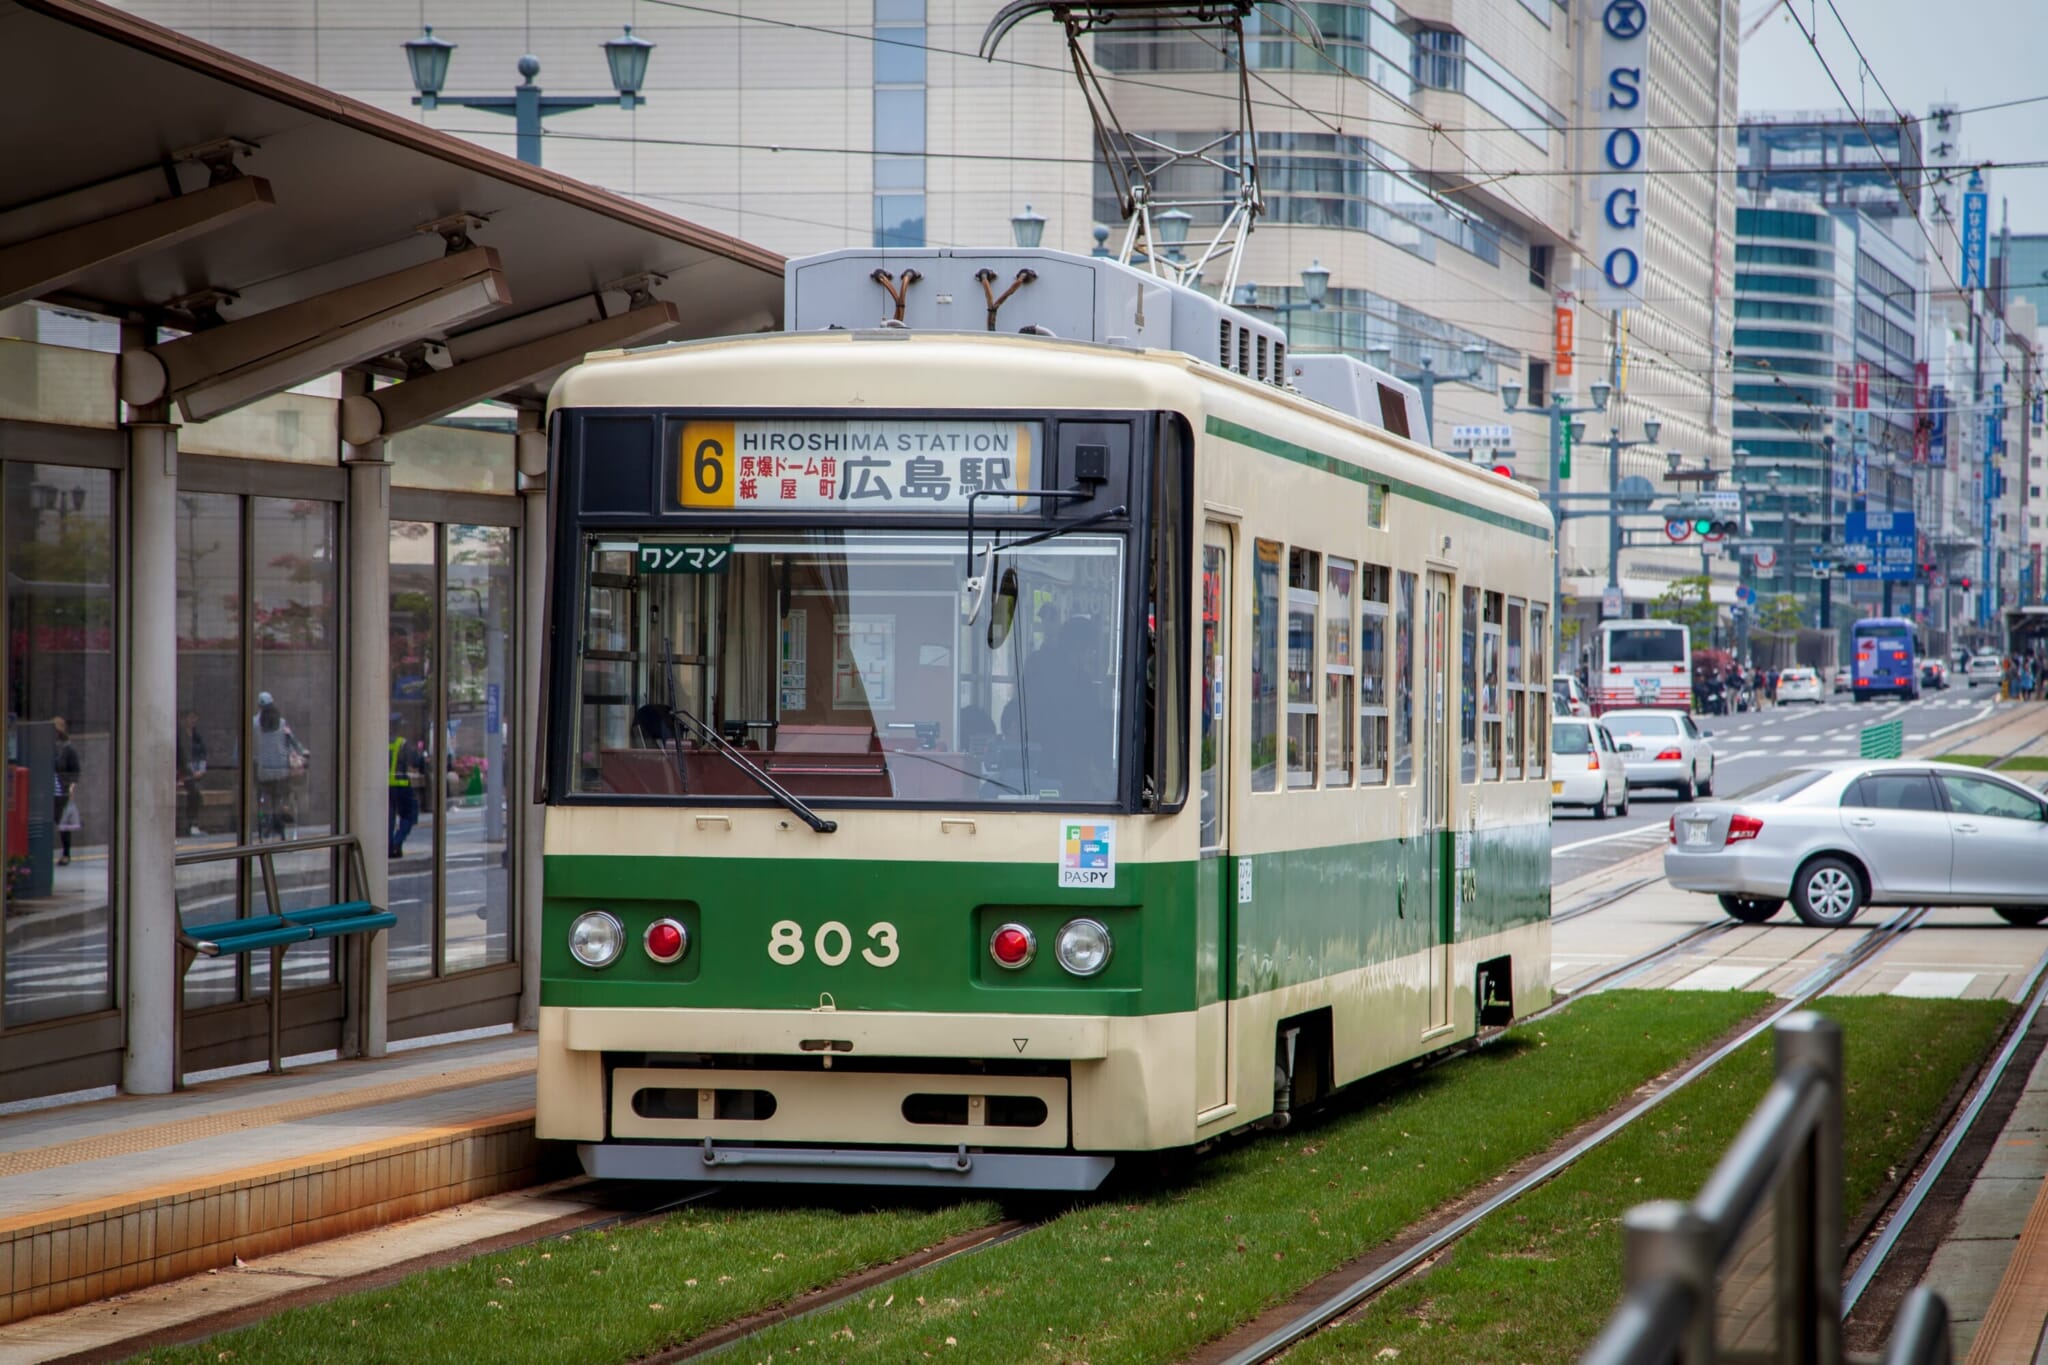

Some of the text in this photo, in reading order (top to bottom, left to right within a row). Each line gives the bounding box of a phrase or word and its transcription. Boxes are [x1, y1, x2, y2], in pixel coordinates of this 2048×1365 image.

[1604, 67, 1641, 290] SOGO
[743, 433, 1009, 452] HIROSHIMA STATION
[693, 438, 724, 494] 6
[739, 456, 836, 478] 原爆ドーム前
[739, 478, 836, 500] 紙屋町
[838, 456, 1011, 501] 広島駅
[642, 548, 727, 568] ワンマン
[1064, 871, 1108, 883] PASPY
[767, 919, 900, 967] 803
